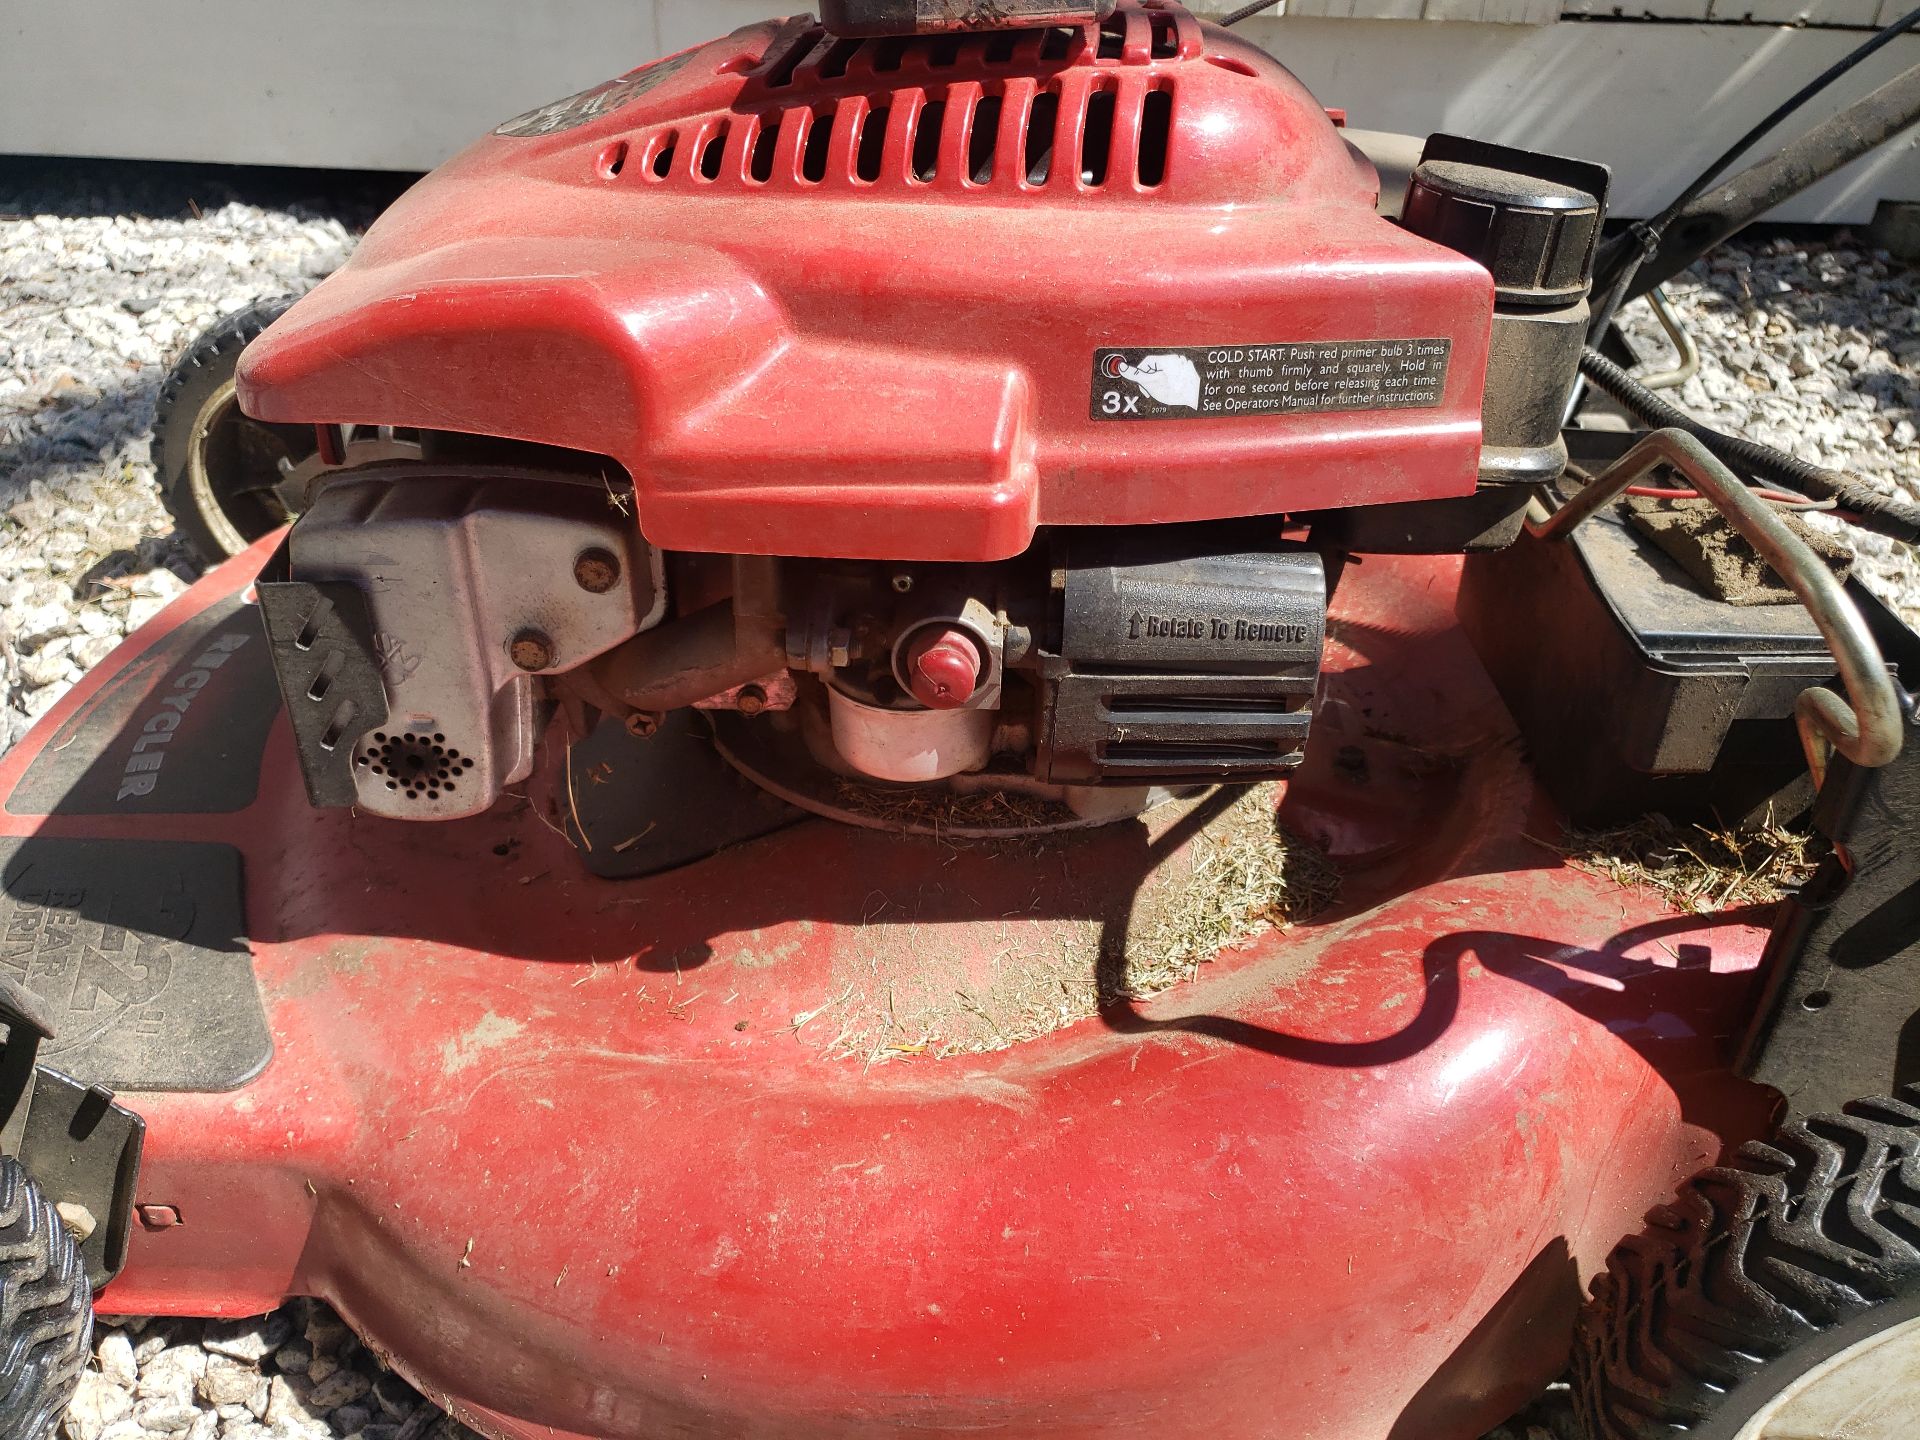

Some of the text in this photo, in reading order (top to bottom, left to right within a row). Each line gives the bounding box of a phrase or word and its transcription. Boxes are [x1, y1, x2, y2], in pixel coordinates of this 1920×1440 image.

[1208, 344, 1444, 363] COLD START: Push red primer bulb 3 times
[1206, 359, 1442, 379] with thumb firmly and squarely. Hold in
[1204, 375, 1439, 396] for one second before releasing each time.
[1203, 391, 1436, 412] See Operators Manual for further instructions.
[1147, 615, 1307, 644] Rotate To Remove
[29, 889, 87, 979] REAR
